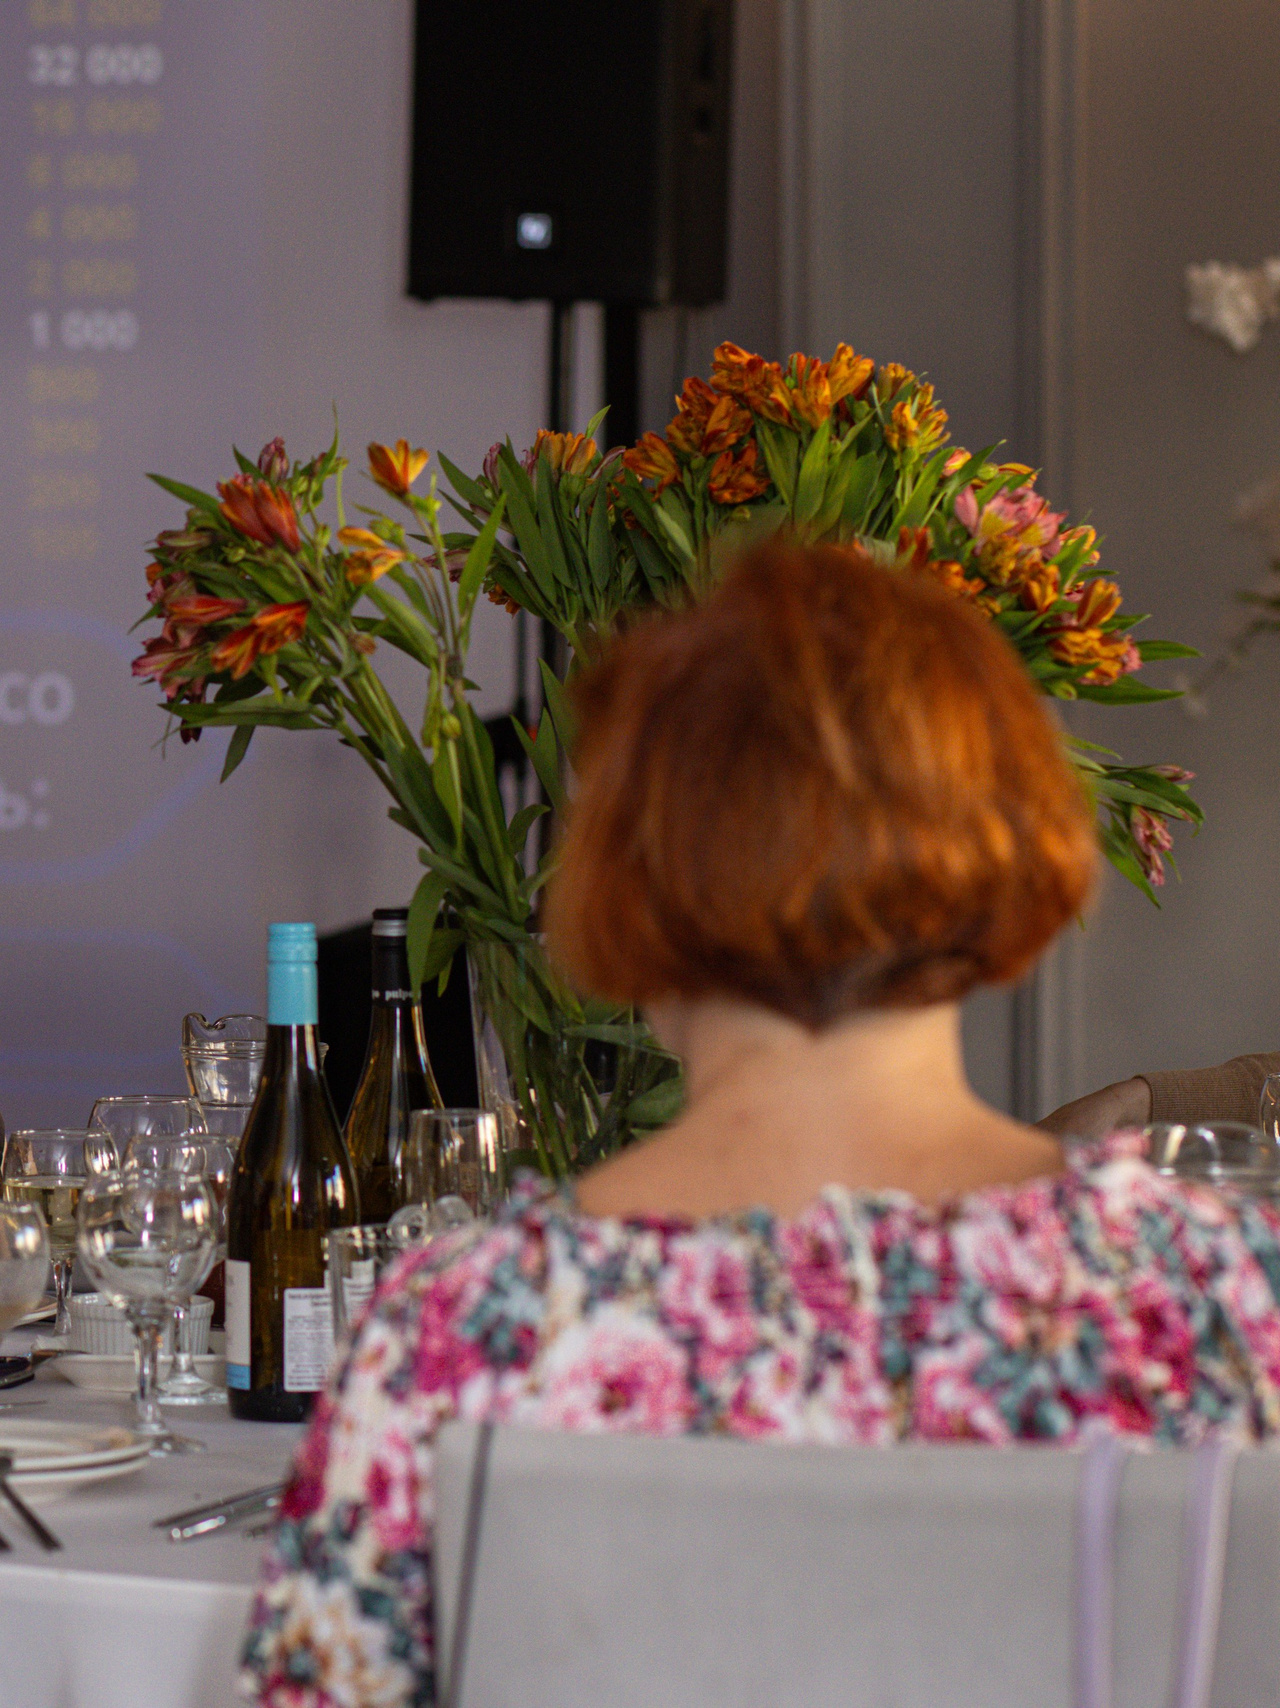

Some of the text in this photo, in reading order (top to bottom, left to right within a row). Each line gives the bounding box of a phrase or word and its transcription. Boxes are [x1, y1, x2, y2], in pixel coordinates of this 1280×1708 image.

[28, 45, 78, 85] 32
[85, 44, 164, 85] 000
[30, 311, 51, 349] 1
[61, 309, 138, 349] 000
